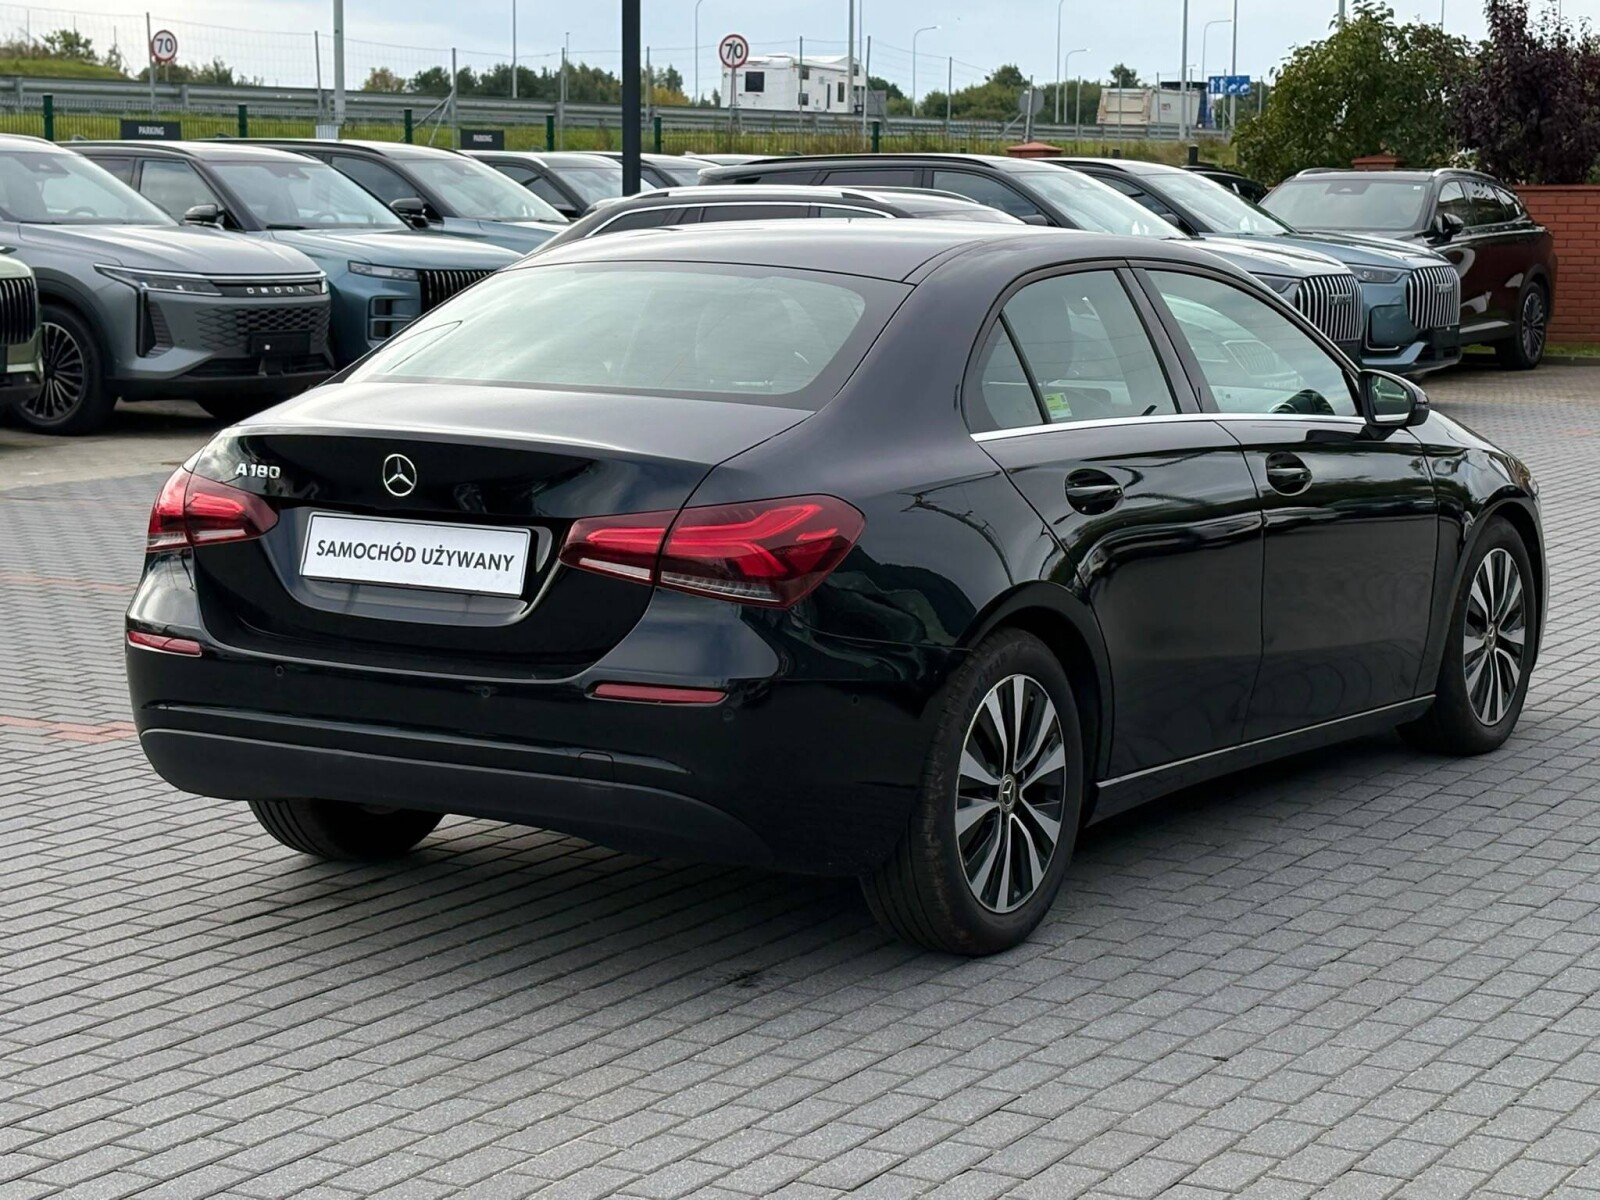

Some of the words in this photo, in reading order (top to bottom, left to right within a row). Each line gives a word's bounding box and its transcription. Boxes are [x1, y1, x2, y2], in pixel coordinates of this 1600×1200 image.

[156, 38, 173, 53] 70
[725, 43, 743, 59] 70
[138, 126, 165, 136] PARKING
[316, 539, 416, 563] SAMOCHÓD
[421, 544, 515, 572] UŻYWANY
